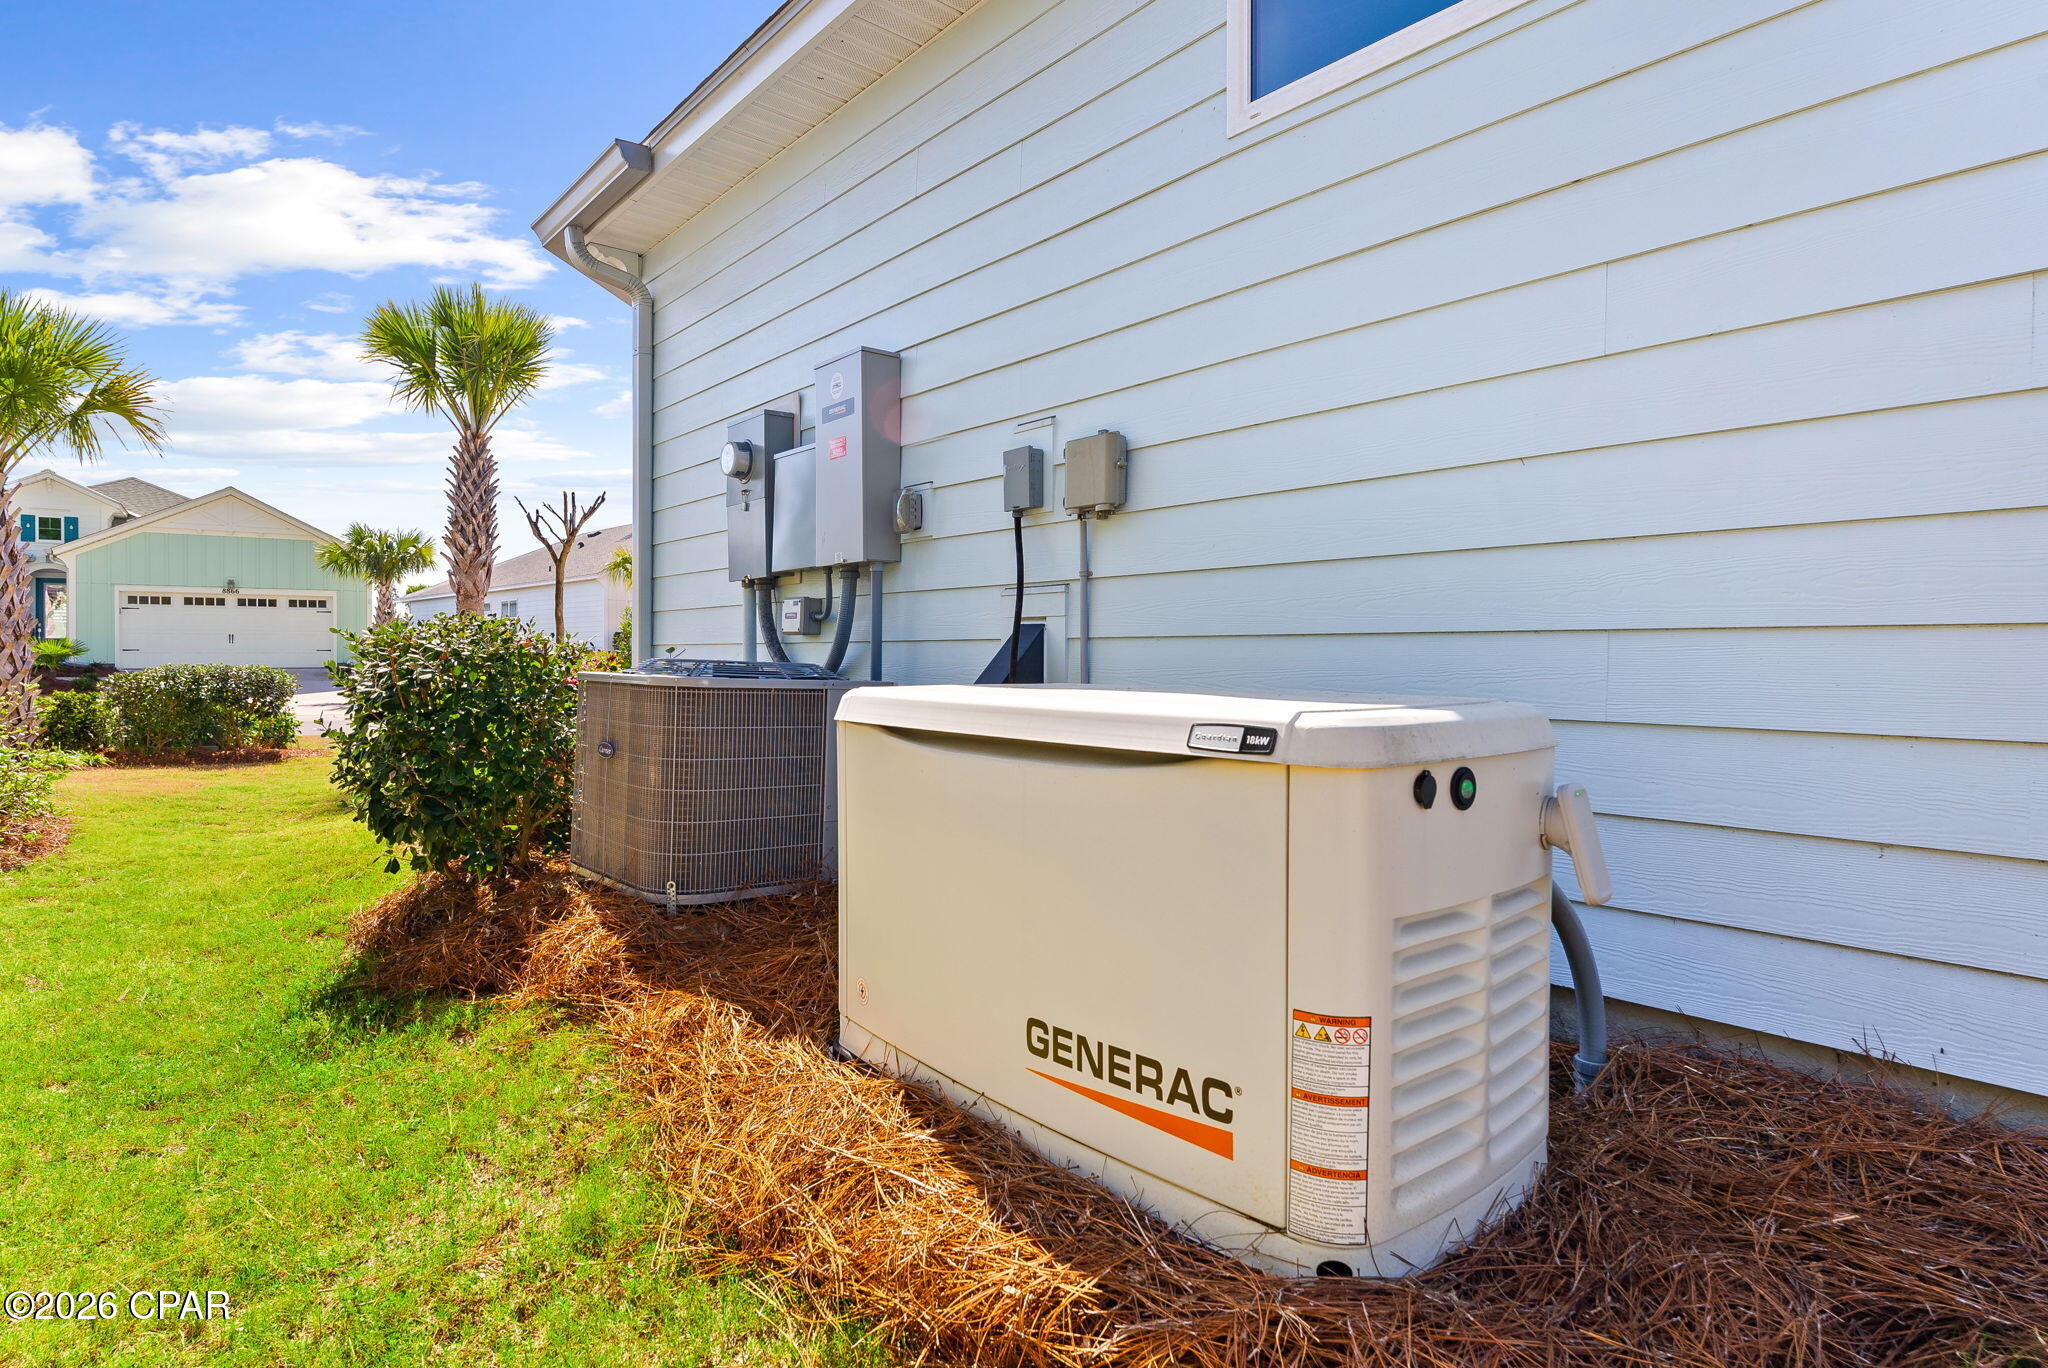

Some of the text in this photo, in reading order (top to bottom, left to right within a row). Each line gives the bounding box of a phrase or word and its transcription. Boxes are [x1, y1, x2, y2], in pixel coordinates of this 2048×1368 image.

[1246, 735, 1271, 746] 18kW
[1319, 1017, 1357, 1026] WARNING
[1303, 1093, 1365, 1106] AVERTISSEMENT
[1306, 1166, 1361, 1179] ADVERTENCIA
